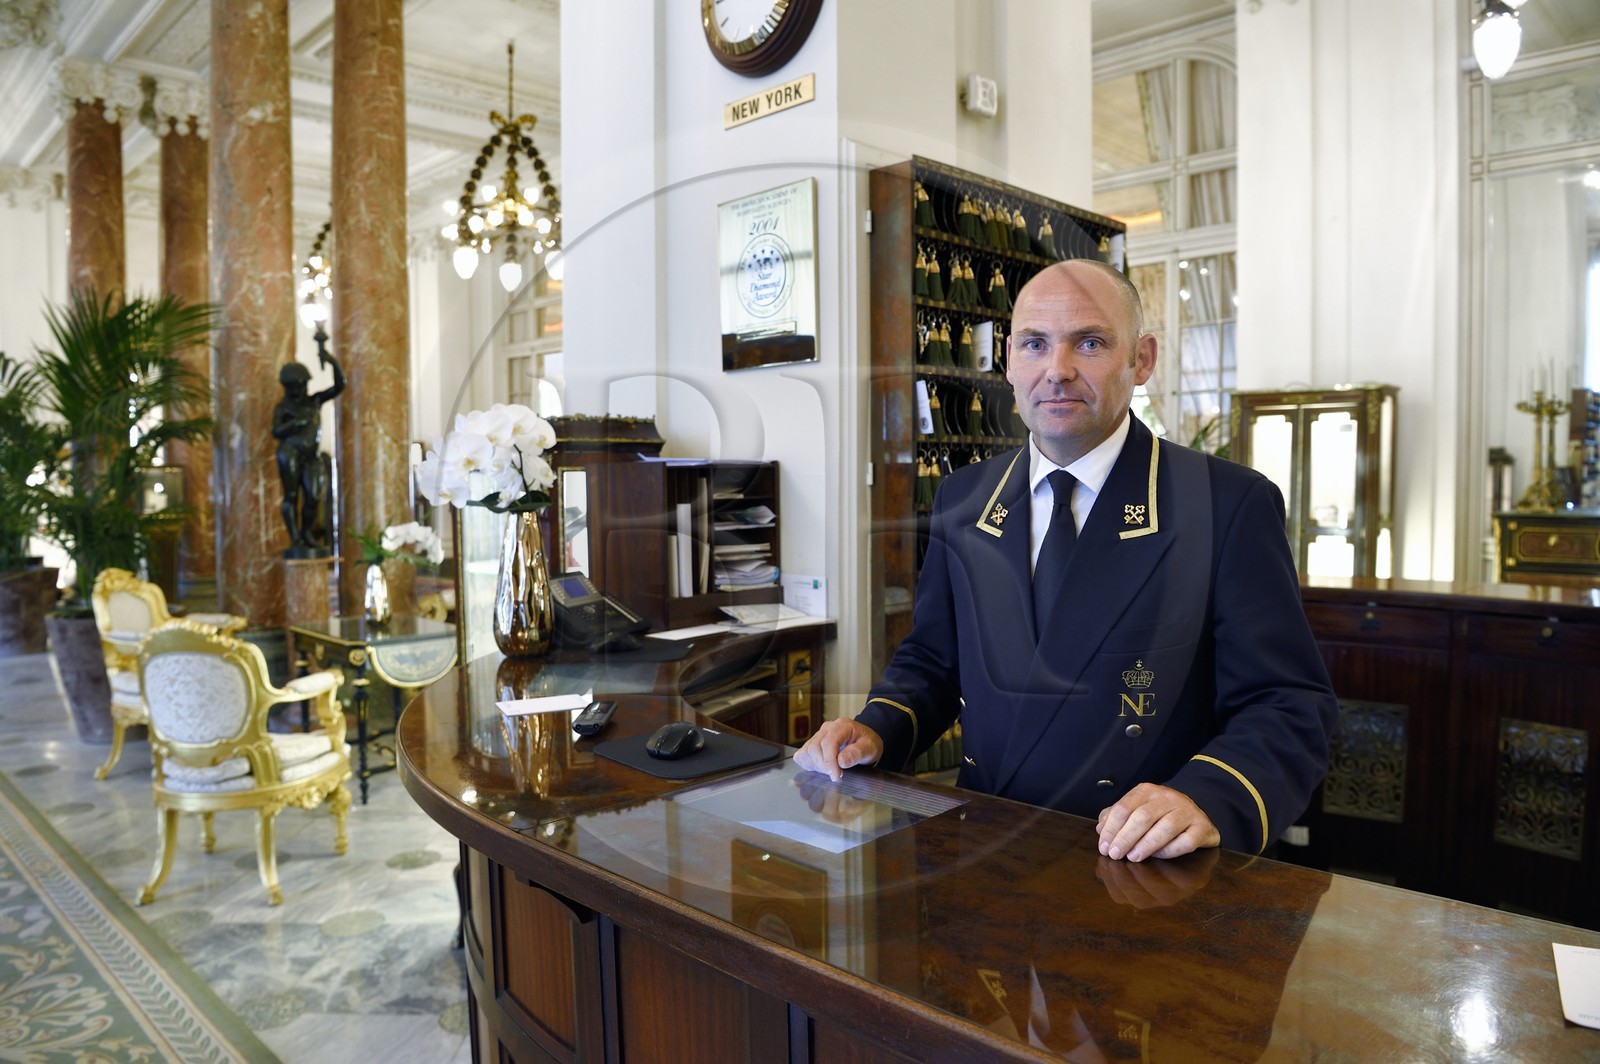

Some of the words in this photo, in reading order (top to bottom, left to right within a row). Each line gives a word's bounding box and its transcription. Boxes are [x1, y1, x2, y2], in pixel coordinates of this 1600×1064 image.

[732, 98, 760, 122] NEW
[765, 82, 803, 109] YORK
[749, 216, 780, 236] 2001
[749, 277, 781, 293] Diamond
[757, 271, 773, 281] Star
[1118, 692, 1157, 717] NE
